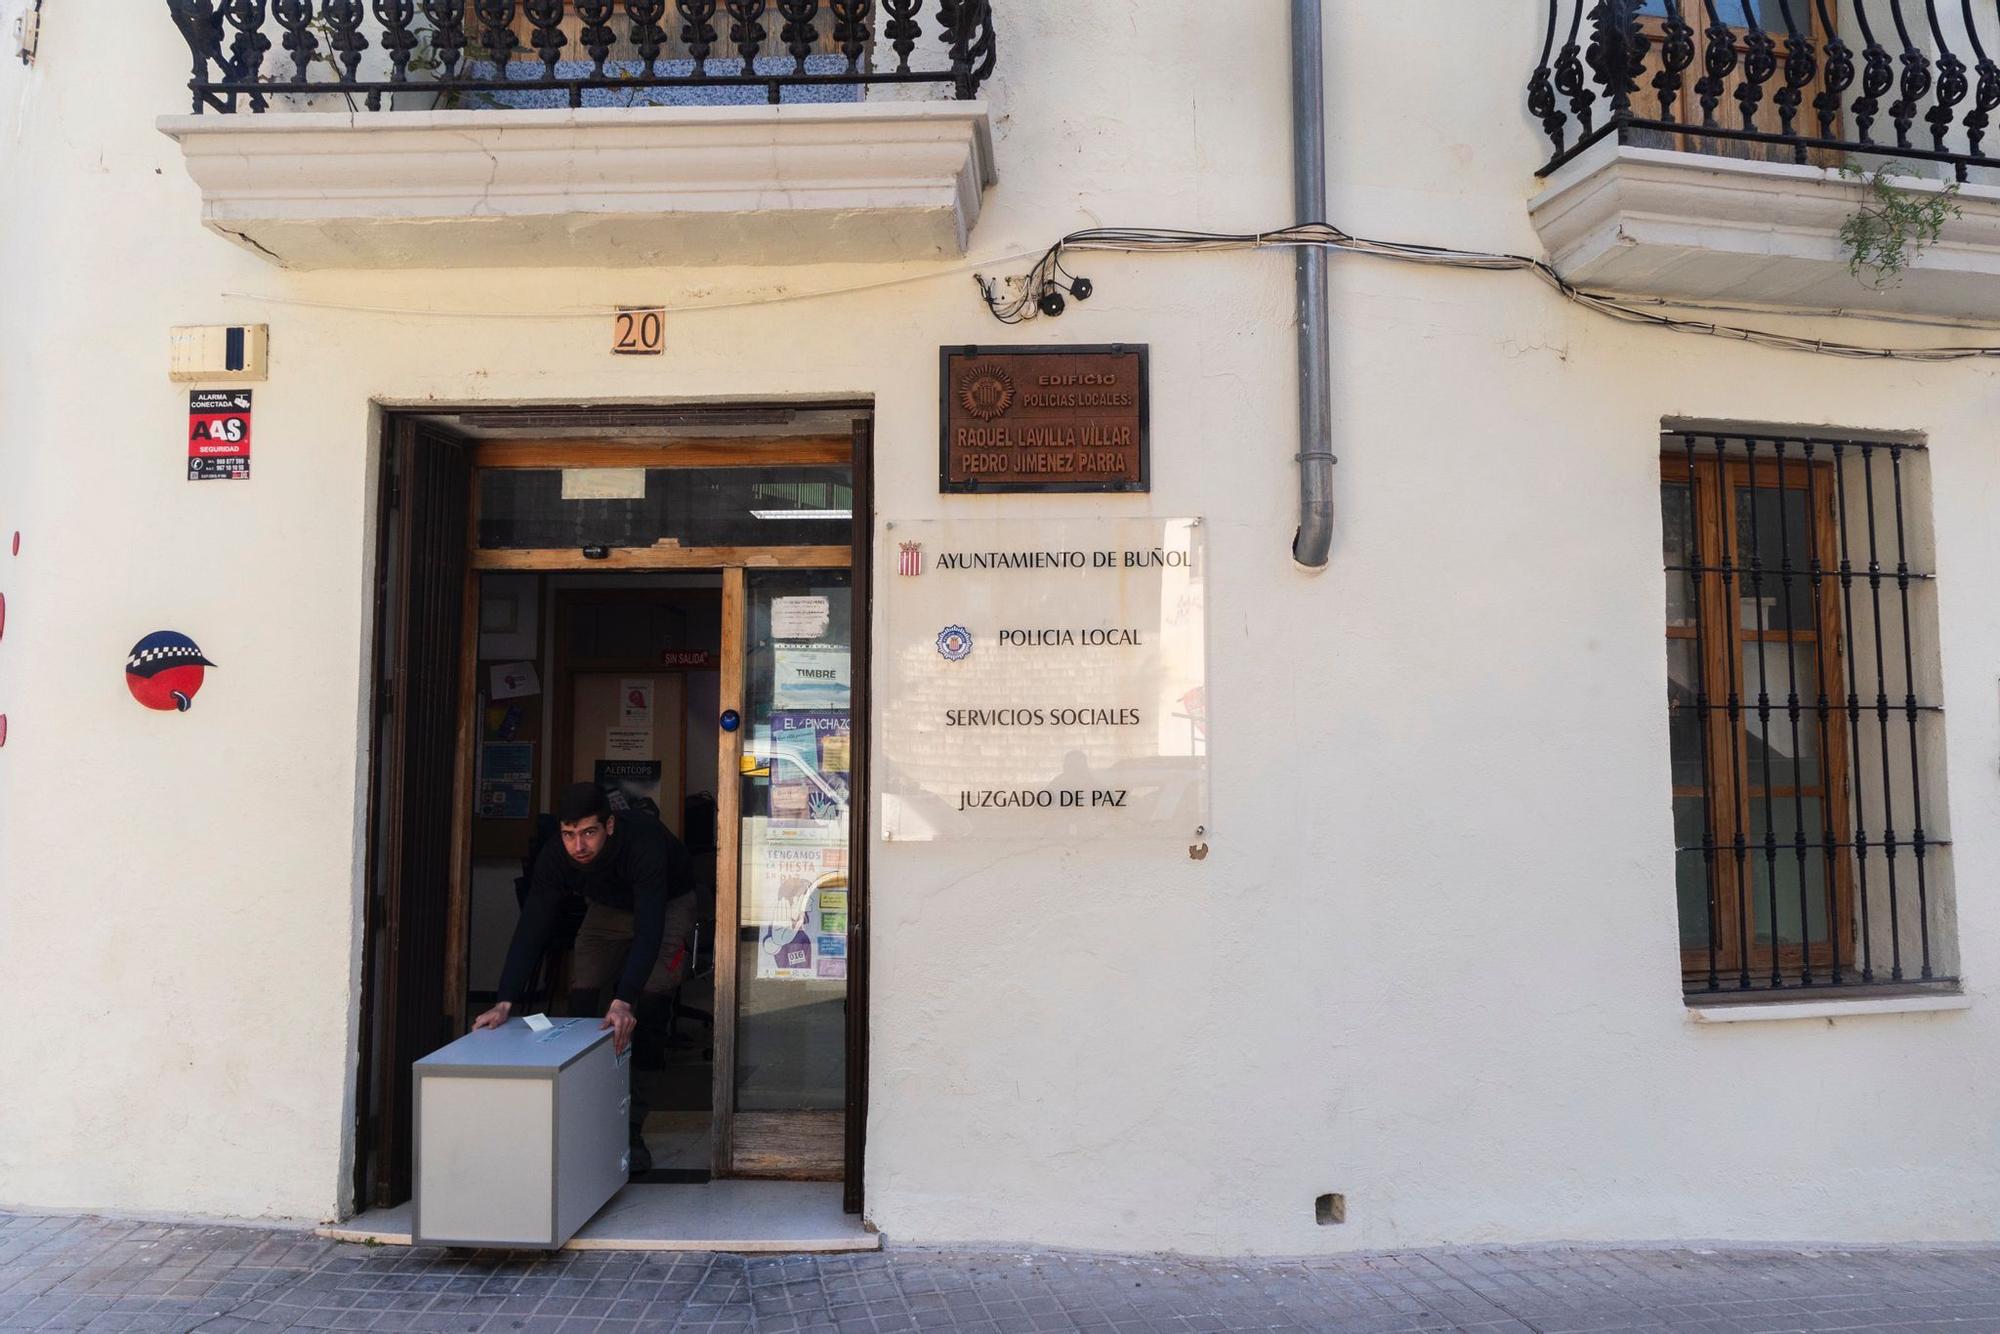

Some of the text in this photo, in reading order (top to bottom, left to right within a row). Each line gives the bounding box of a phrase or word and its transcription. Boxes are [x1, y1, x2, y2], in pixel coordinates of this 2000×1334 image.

[616, 312, 661, 348] 20
[1039, 375, 1116, 385] EDIFICIO
[1024, 393, 1132, 407] POLICIAS LOCALES:
[191, 418, 242, 442] AAS
[1018, 427, 1076, 446] LAVILLA
[1081, 426, 1131, 446] VILLAR
[962, 453, 1126, 473] PEDRO JIMENEZ PARRA
[936, 548, 1192, 569] AYUNTAMIENTO DE BUÑOL
[999, 629, 1142, 647] POLICIA LOCAL
[665, 653, 705, 664] SIN SALIDA
[796, 668, 837, 679] TIMBRE
[783, 718, 797, 730] EL
[945, 708, 1140, 726] SERVICIOS SOCIALES
[605, 766, 653, 776] ALERTCOPS
[958, 790, 1127, 811] JUZGADO DE PAZ
[768, 850, 820, 860] TENGAMOS
[779, 861, 815, 873] FIESTA
[789, 951, 804, 961] 016
